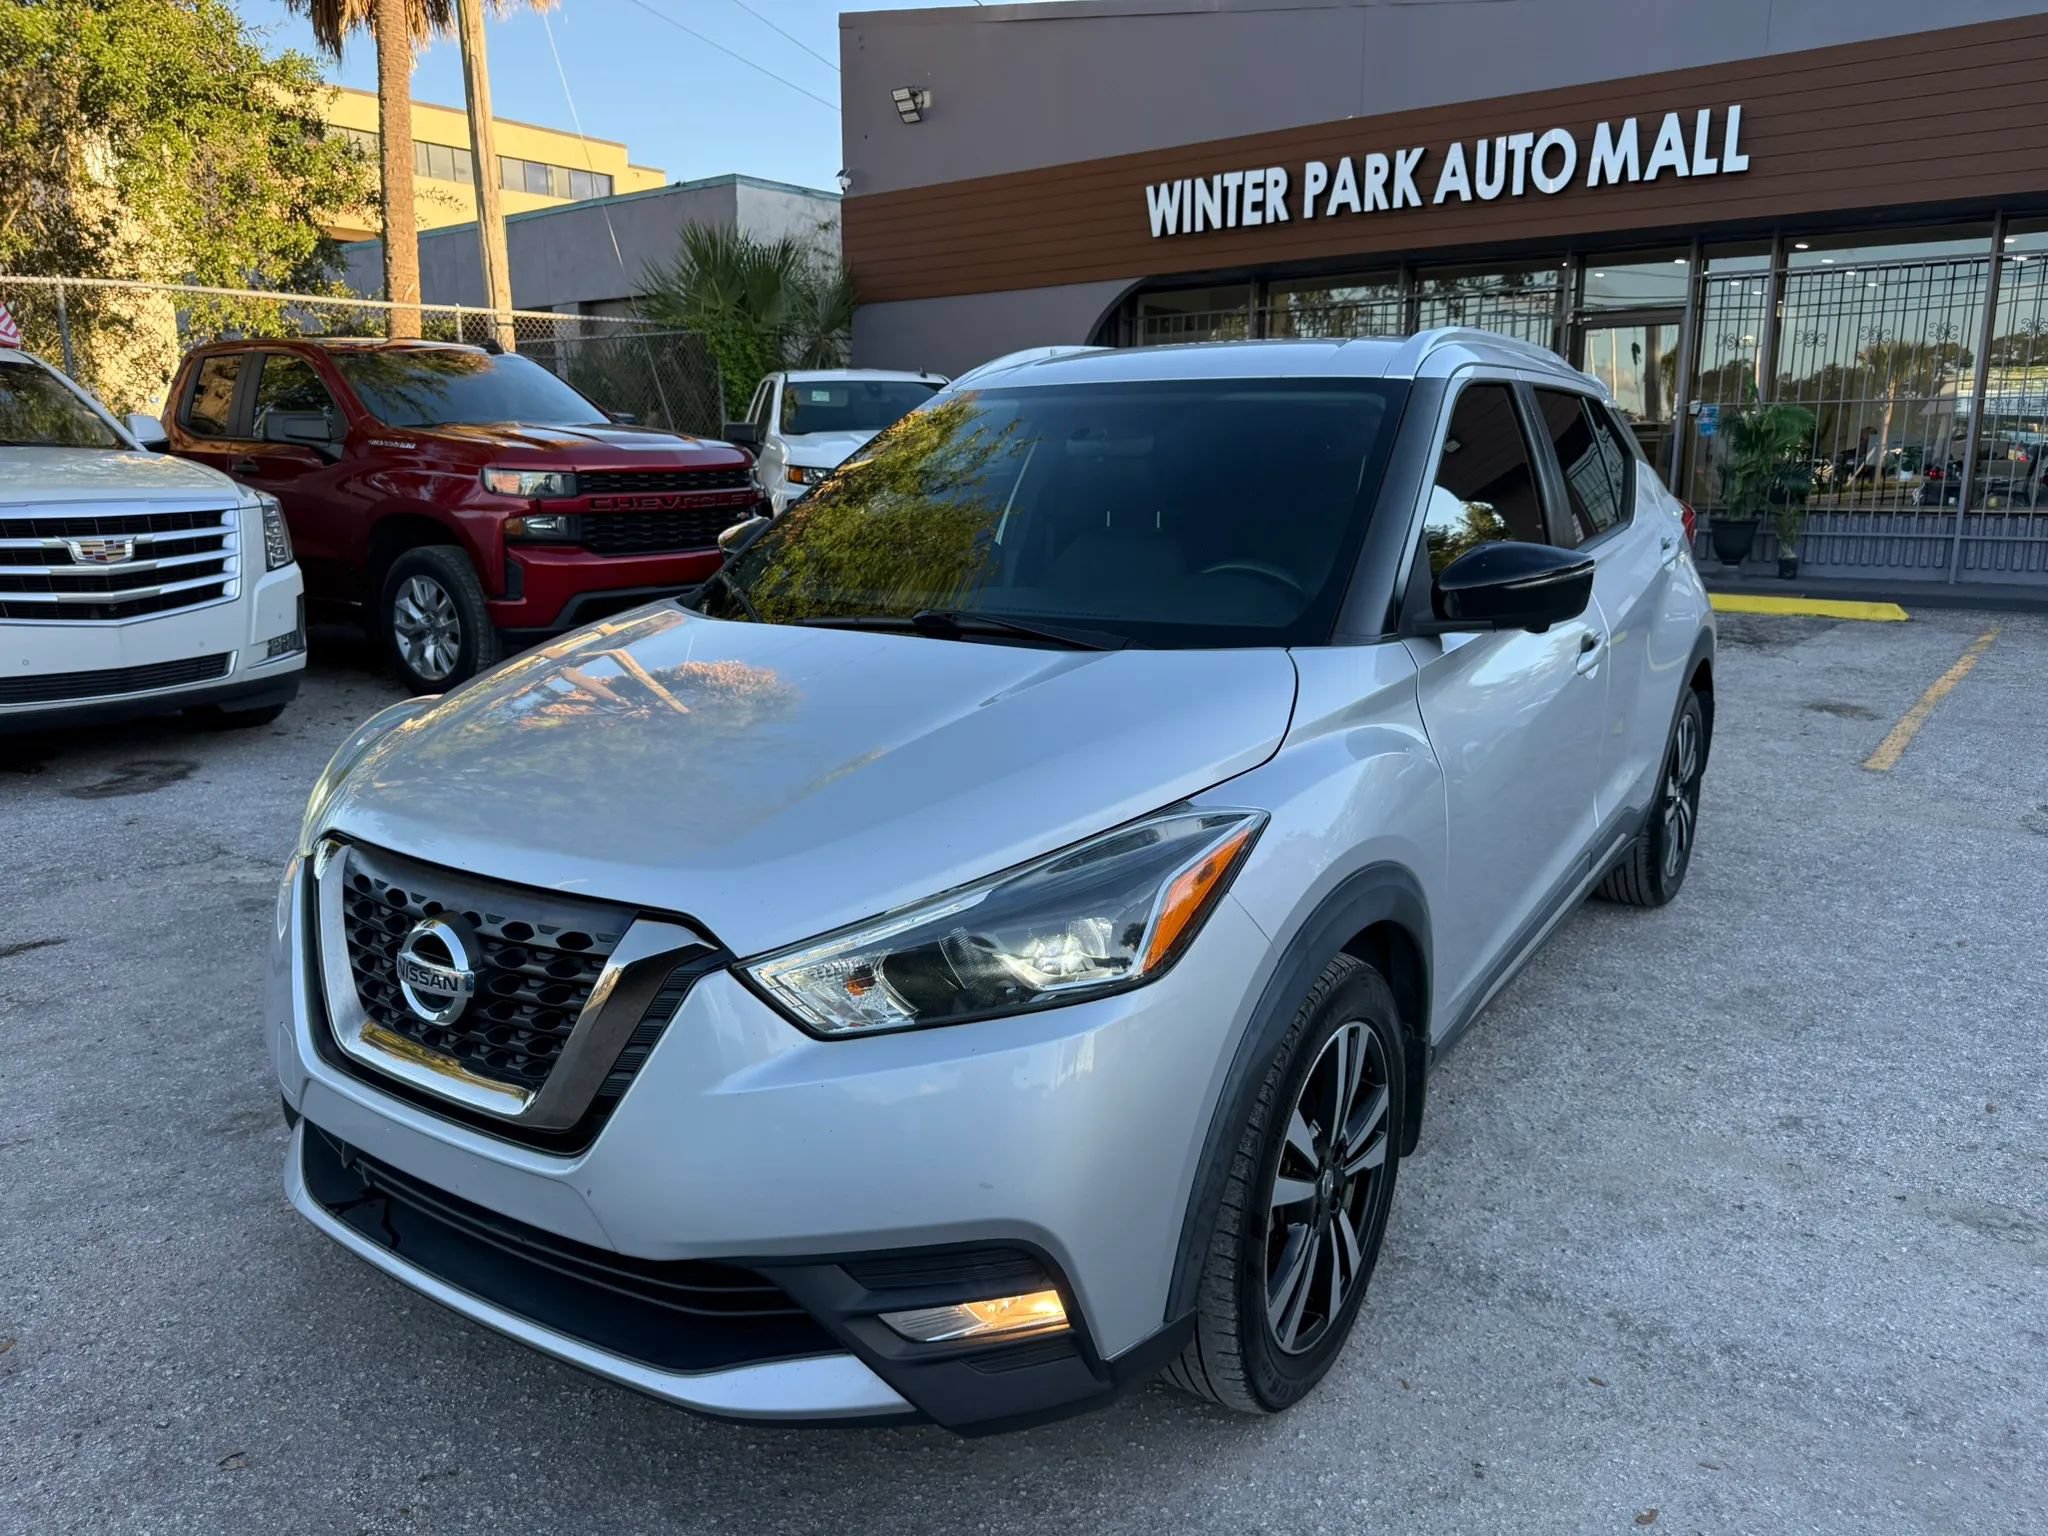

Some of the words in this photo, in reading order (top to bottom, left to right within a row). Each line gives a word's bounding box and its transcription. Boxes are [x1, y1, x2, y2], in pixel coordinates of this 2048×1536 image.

[1145, 167, 1290, 238] WINTER
[1303, 147, 1425, 219] PARK
[1433, 128, 1577, 204] AUTO
[1587, 105, 1750, 187] MALL
[399, 960, 459, 992] NISSAN
